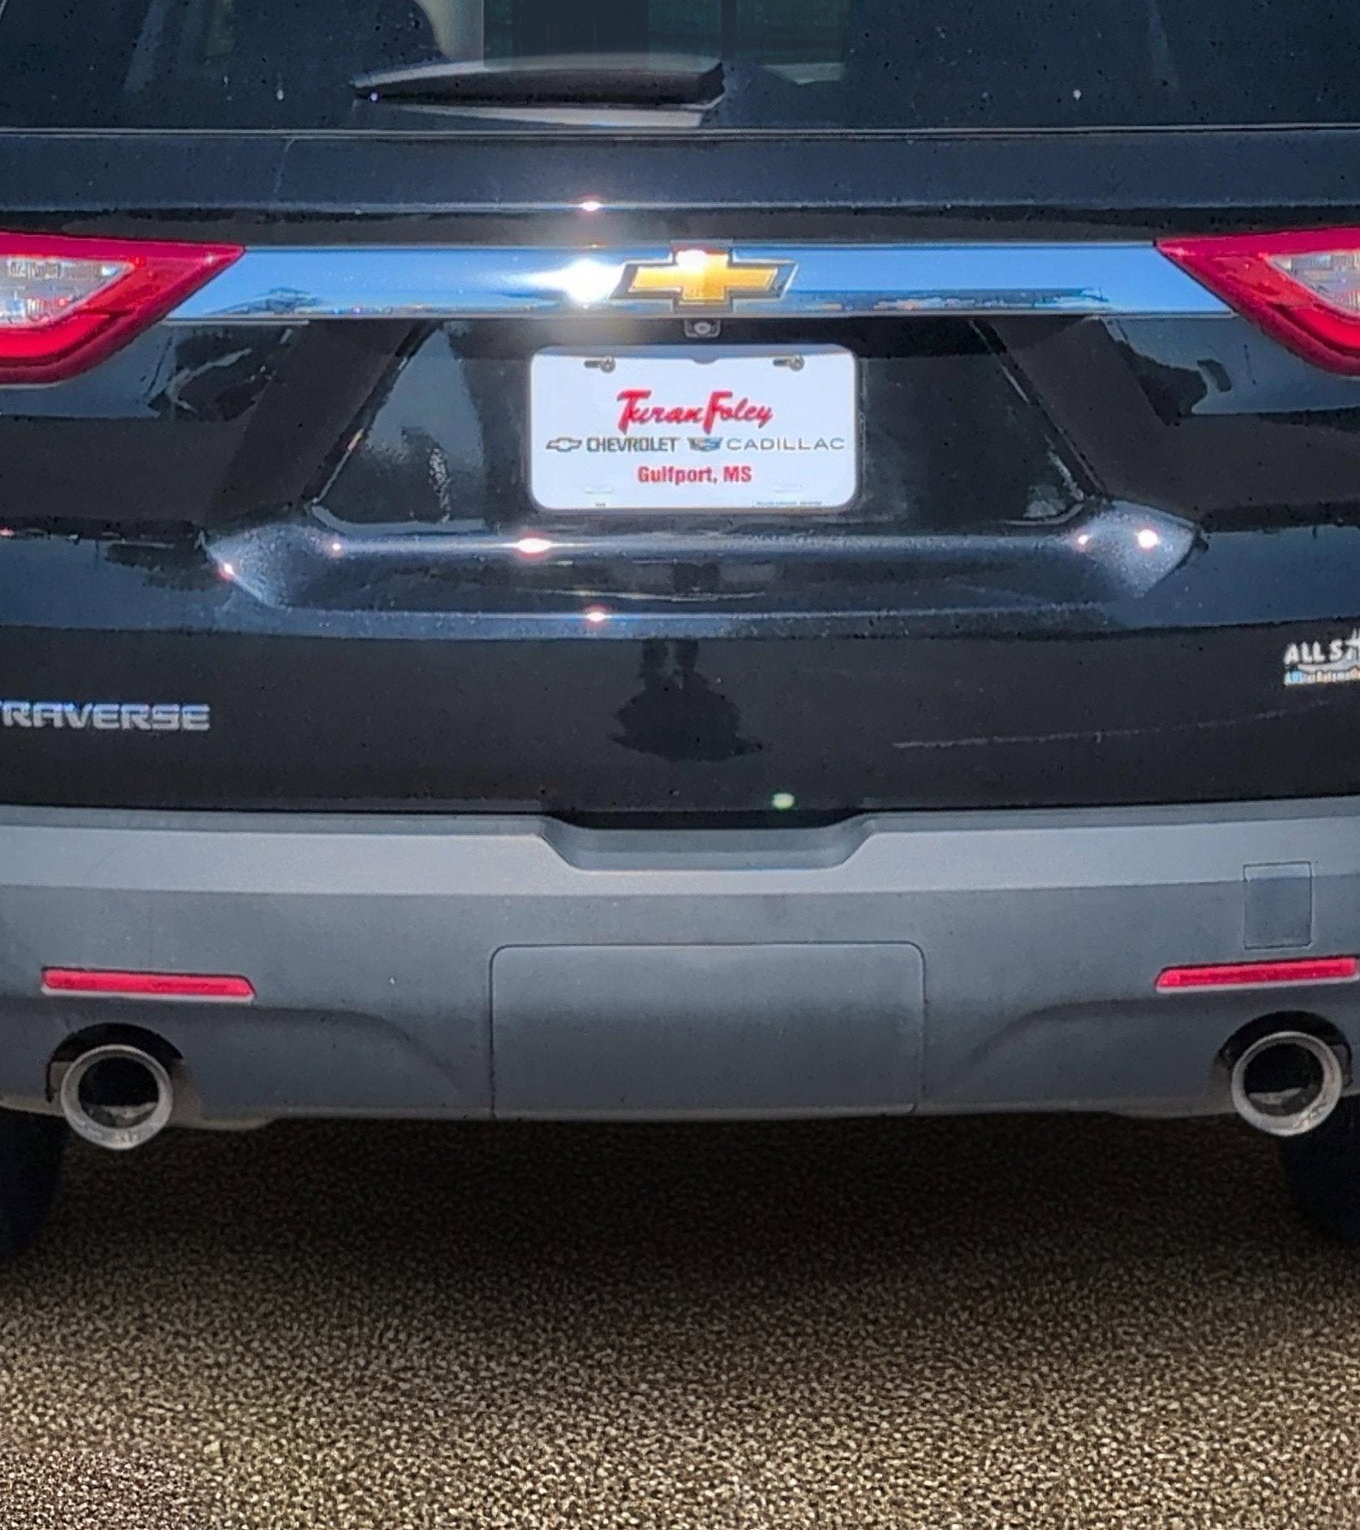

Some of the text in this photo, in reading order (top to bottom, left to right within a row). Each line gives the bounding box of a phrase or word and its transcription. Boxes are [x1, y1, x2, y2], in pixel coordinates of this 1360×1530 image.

[617, 390, 773, 435] Turan Foley
[586, 437, 845, 453] CHEVROLET CADILLAC
[637, 465, 752, 486] Gulfport, MS
